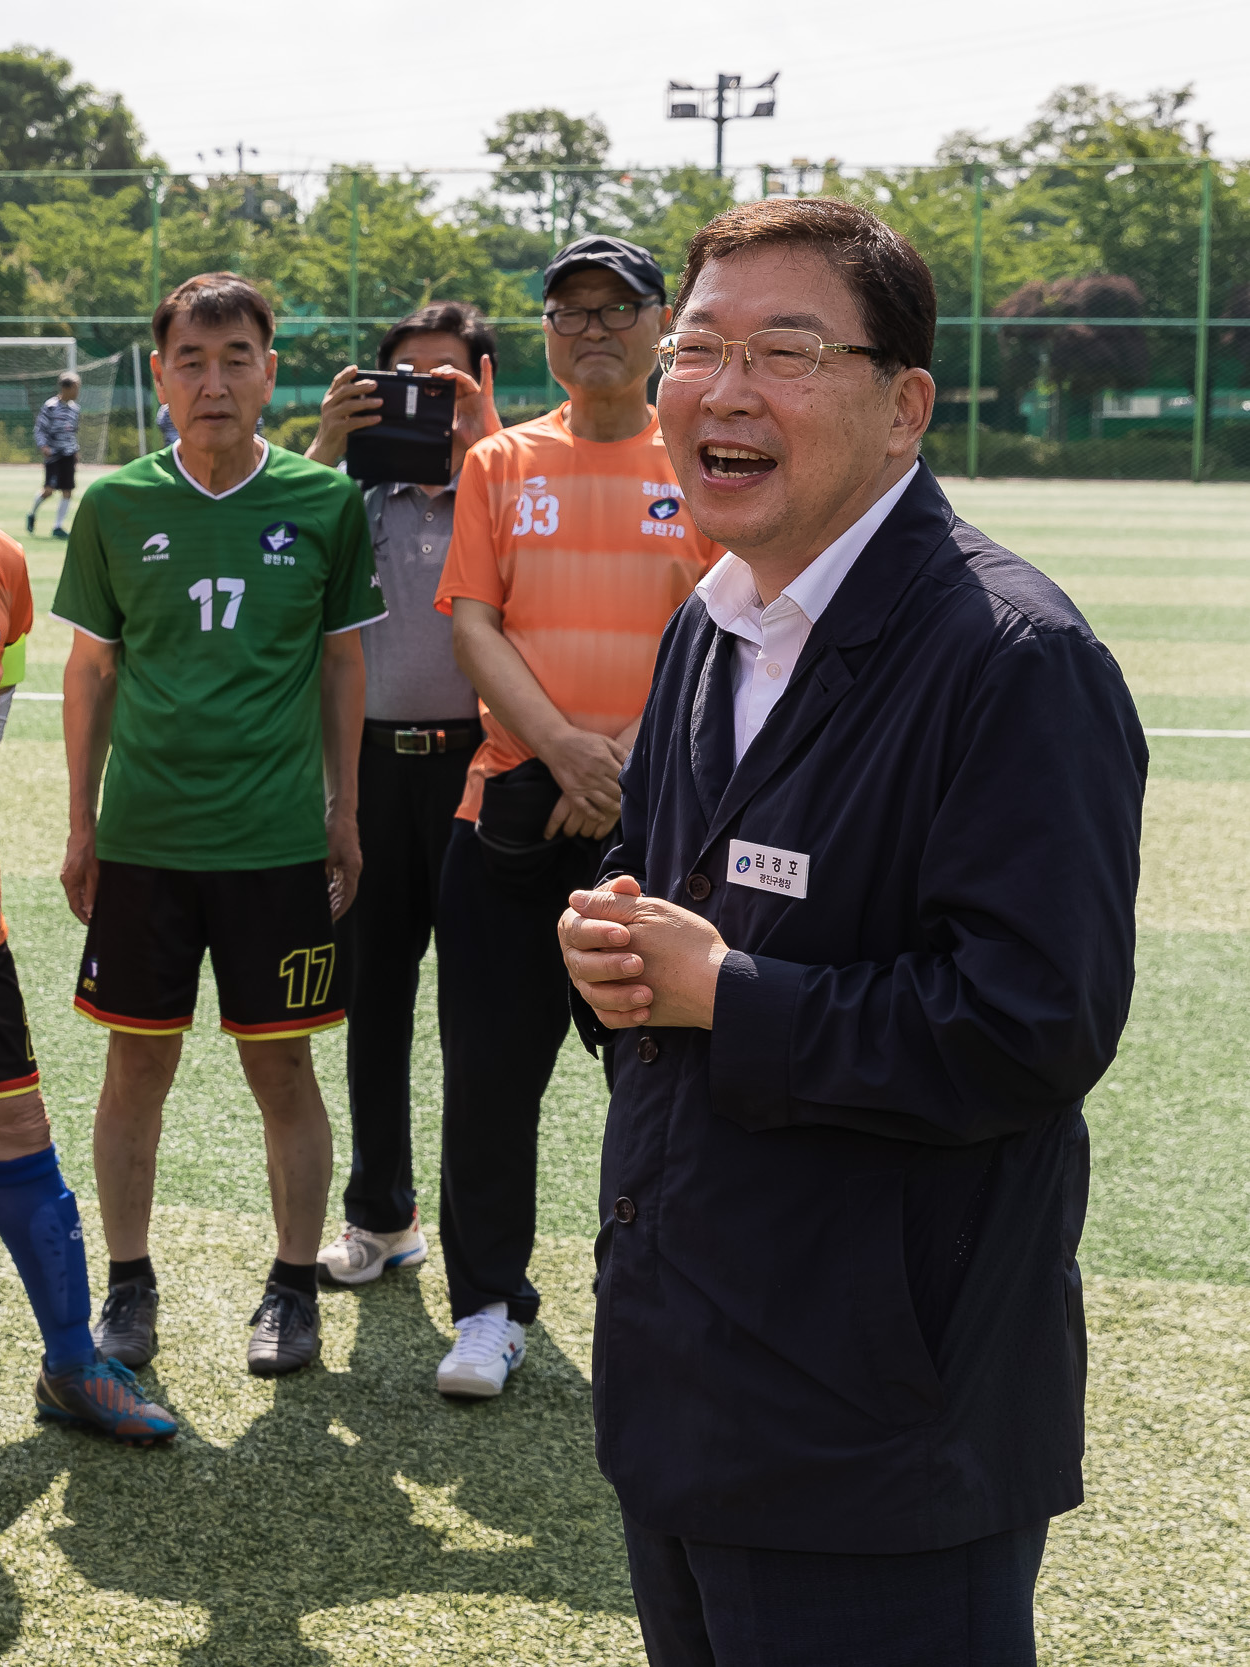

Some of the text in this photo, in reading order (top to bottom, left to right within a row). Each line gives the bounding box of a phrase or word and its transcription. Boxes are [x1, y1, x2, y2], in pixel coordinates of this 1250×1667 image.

[512, 493, 559, 536] 33
[283, 555, 296, 566] 70
[188, 577, 246, 632] 17
[759, 873, 791, 889] 광진구청장
[279, 943, 335, 1008] 17
